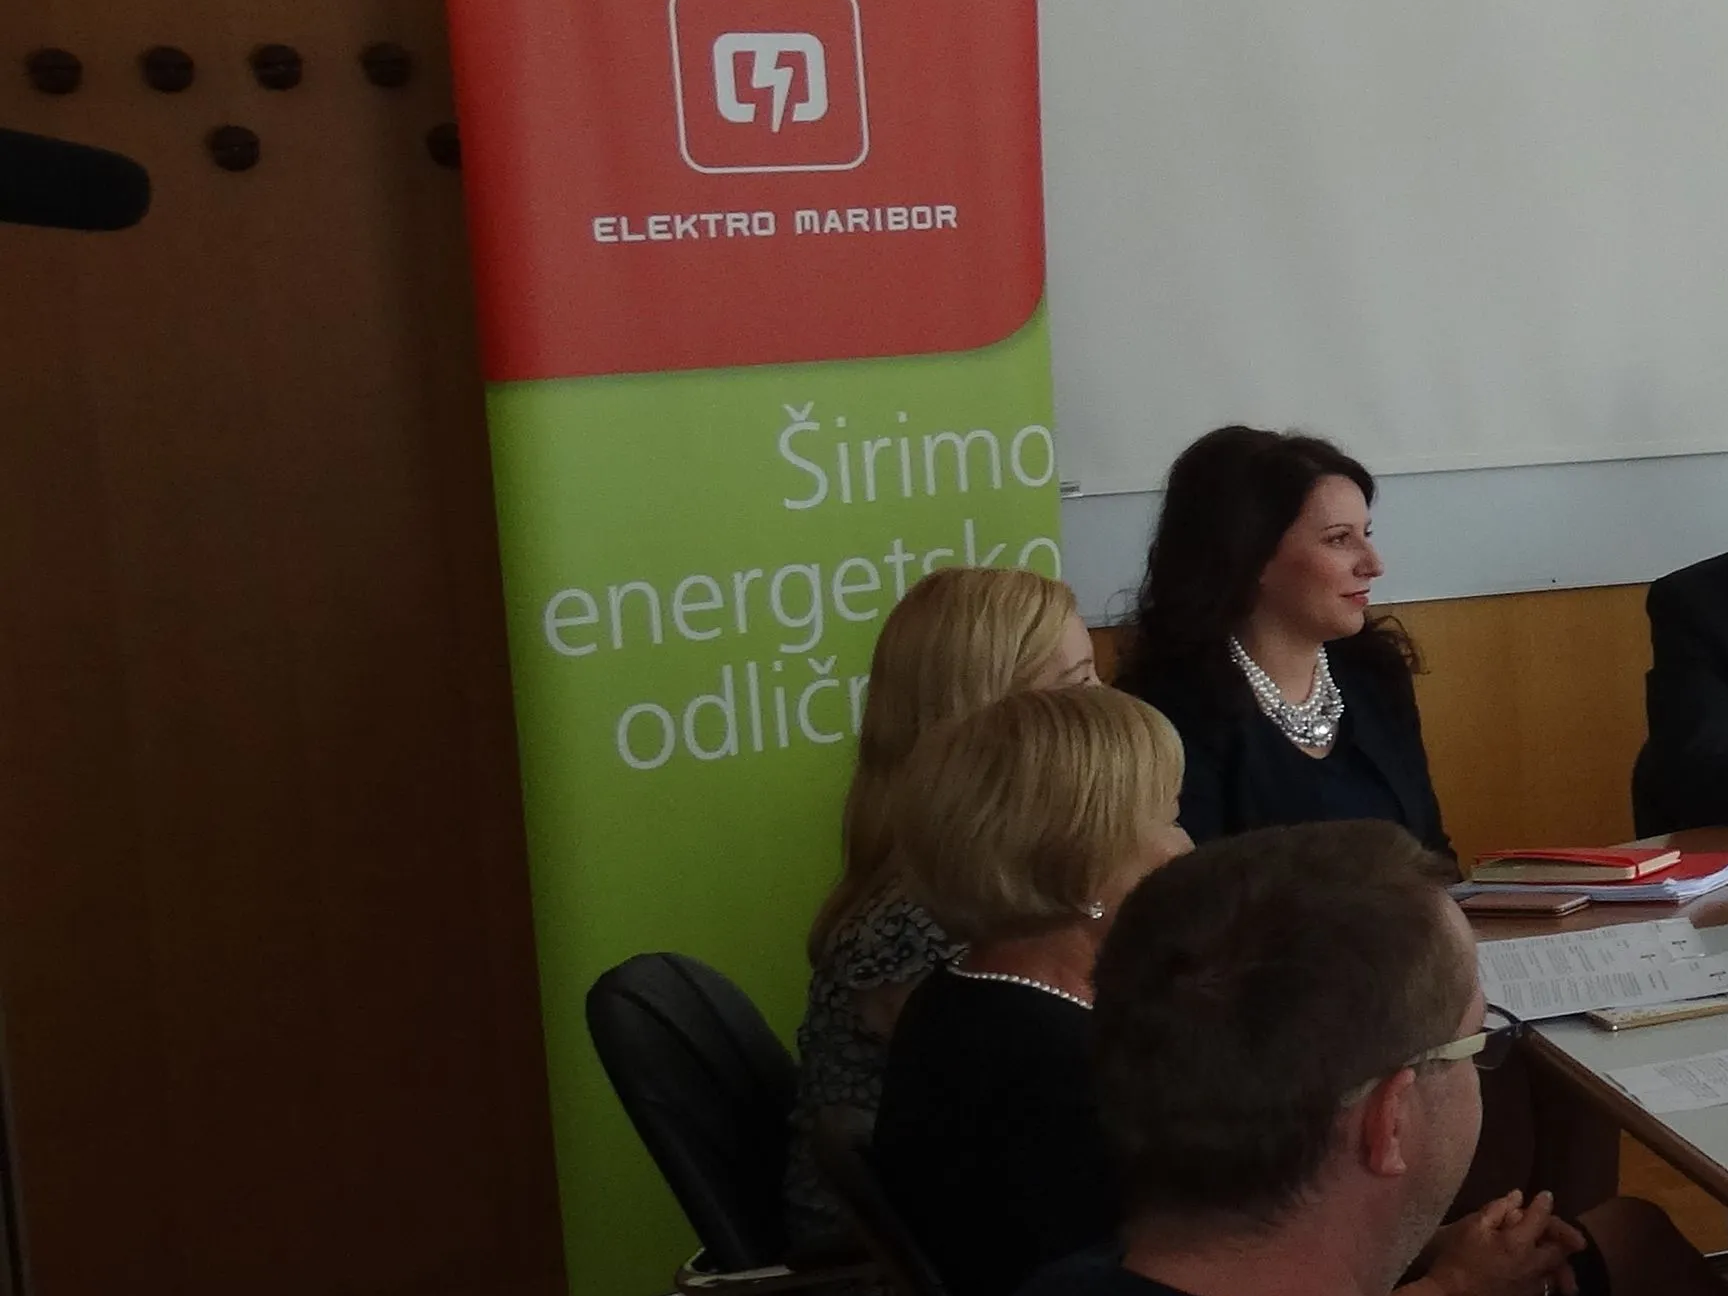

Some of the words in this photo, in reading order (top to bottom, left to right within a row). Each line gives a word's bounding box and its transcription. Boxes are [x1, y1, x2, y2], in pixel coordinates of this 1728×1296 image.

[593, 211, 776, 242] ELEKTRO
[795, 205, 958, 235] MARIBOR
[778, 401, 1054, 510] Širimo
